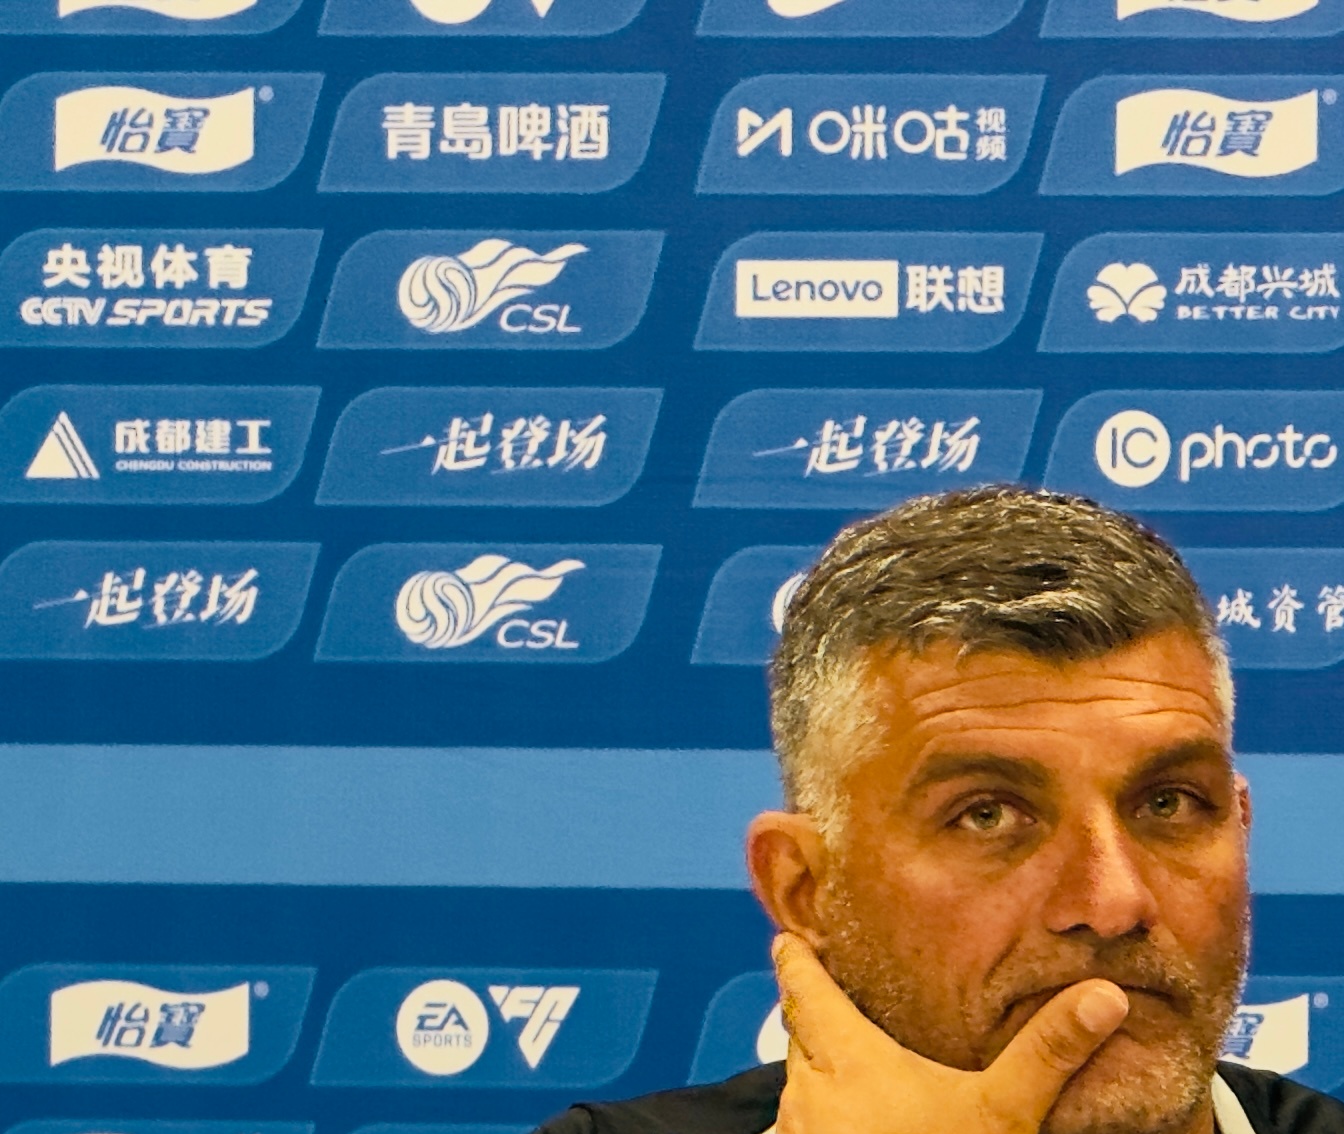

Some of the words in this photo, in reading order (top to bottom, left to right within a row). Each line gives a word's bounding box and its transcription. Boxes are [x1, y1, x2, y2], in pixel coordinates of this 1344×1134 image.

[100, 106, 210, 154] 怡寶
[1161, 109, 1274, 157] 怡寶
[42, 242, 253, 289] 央视体育
[1174, 263, 1340, 300] 成都兴城
[751, 273, 883, 302] Lenovo
[905, 264, 1005, 314] 联想
[20, 296, 105, 326] CCTV
[106, 298, 273, 327] SPORTS
[498, 303, 581, 333] CSL
[1177, 305, 1279, 320] BETTER
[1288, 305, 1339, 320] CITY
[114, 418, 272, 455] 成都建工
[381, 412, 607, 474] 一起登场
[753, 414, 981, 475] 一起登场
[115, 459, 175, 472] CHENGDU
[176, 459, 273, 471] CONSTRUCTION
[34, 567, 259, 628] 一起登场
[496, 618, 579, 649] CSL
[95, 1001, 206, 1049] 怡寶
[415, 1002, 469, 1032] EA
[412, 1032, 473, 1048] SPORTS
